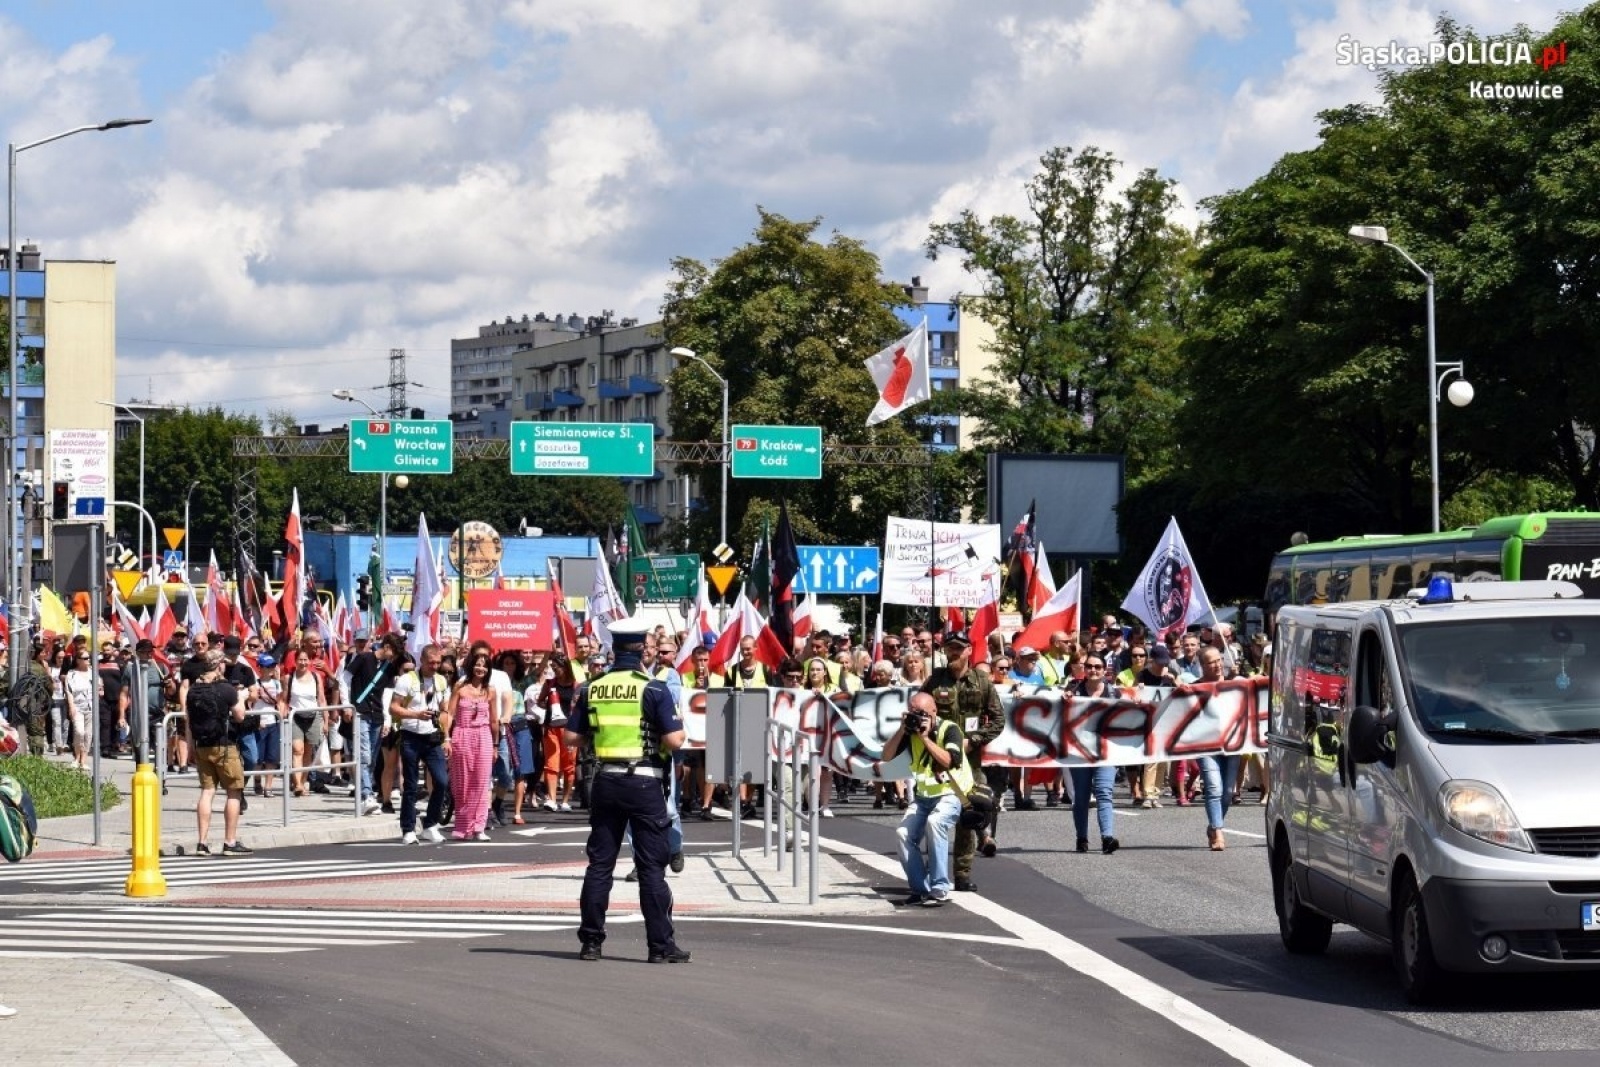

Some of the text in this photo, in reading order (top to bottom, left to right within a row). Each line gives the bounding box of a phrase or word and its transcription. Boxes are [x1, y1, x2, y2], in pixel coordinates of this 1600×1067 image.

[374, 422, 438, 434] 79 Poznań
[534, 426, 616, 438] Siemianowice
[394, 438, 446, 450] Wrocław
[741, 439, 804, 451] 79 Kraków
[394, 454, 439, 466] Gliwice
[760, 454, 789, 466] Łódź
[590, 685, 637, 699] POLICJA
